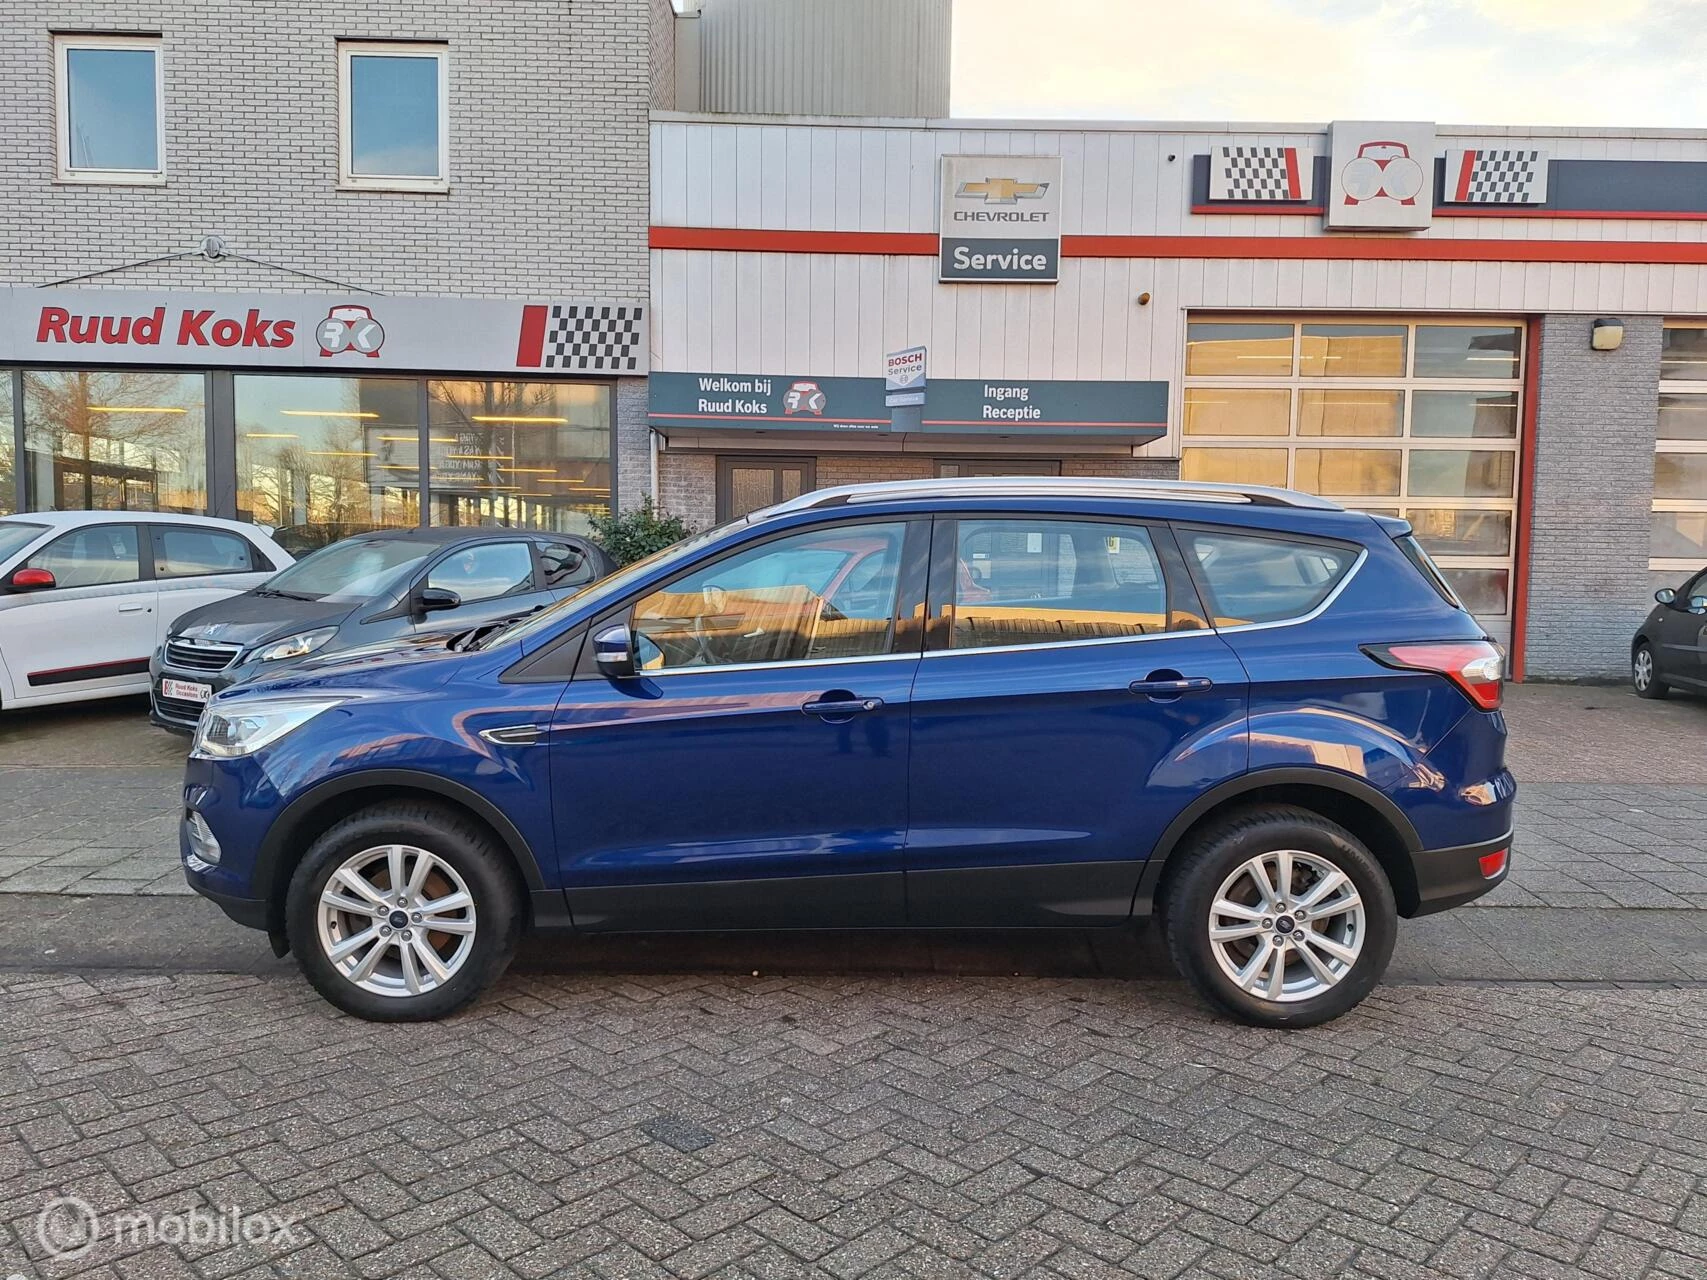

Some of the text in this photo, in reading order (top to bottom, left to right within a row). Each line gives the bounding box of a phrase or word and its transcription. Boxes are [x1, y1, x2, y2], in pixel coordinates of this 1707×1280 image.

[953, 211, 1050, 223] CHEVROLET
[953, 246, 1047, 271] Service
[36, 306, 296, 348] Ruud Koks
[888, 352, 923, 367] BOSCH
[888, 364, 923, 376] Service
[698, 377, 772, 396] Welkom bij
[984, 384, 1029, 402] Ingang
[698, 398, 768, 414] Ruud Koks
[982, 404, 1041, 422] Receptie
